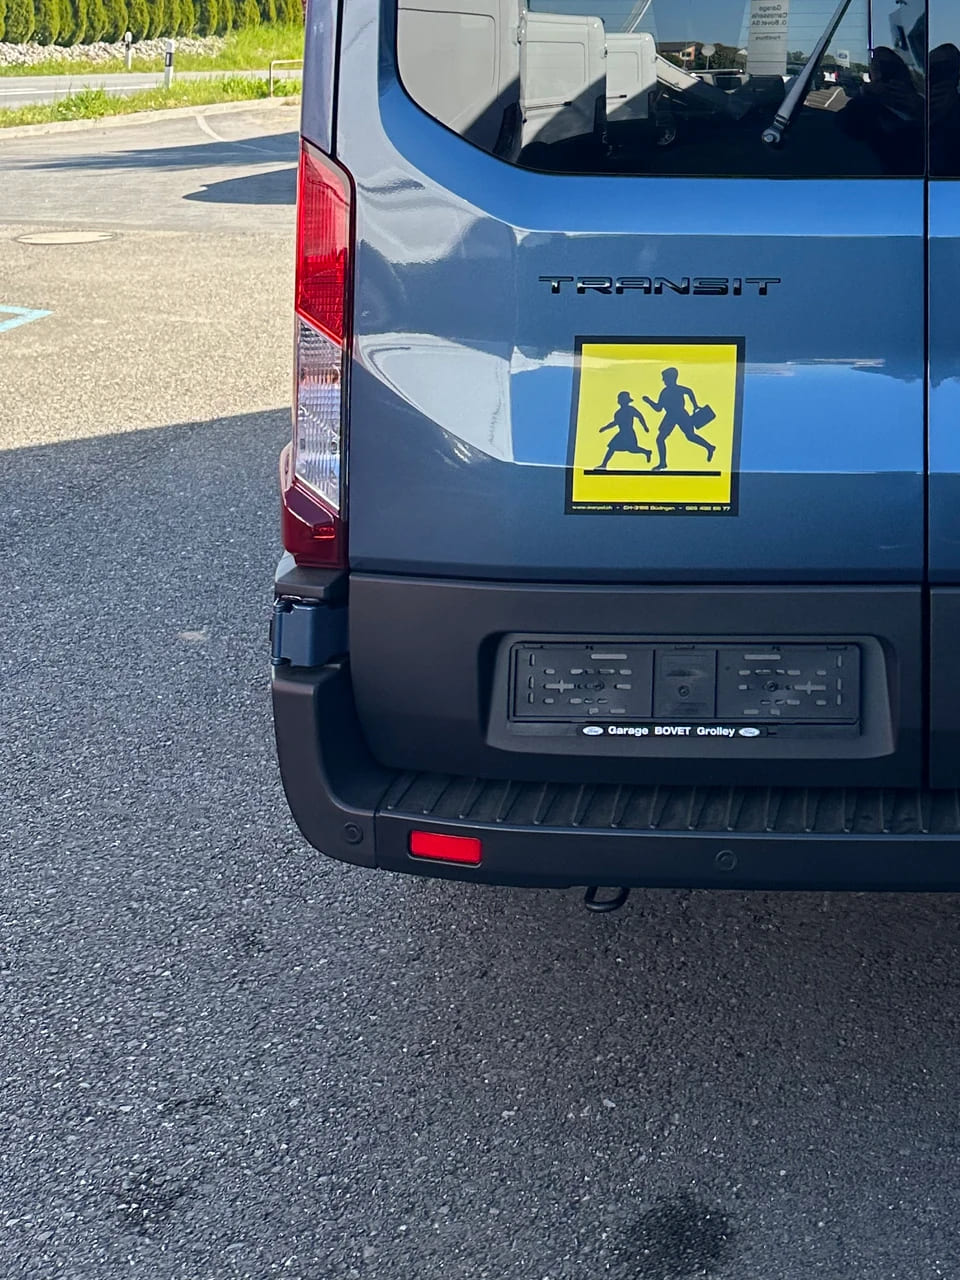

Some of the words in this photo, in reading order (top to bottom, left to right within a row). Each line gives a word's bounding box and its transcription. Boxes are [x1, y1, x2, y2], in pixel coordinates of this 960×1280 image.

[538, 276, 781, 296] TRANSIT
[608, 726, 649, 737] Garage
[654, 726, 692, 736] BOVET
[697, 727, 736, 738] Grolley
